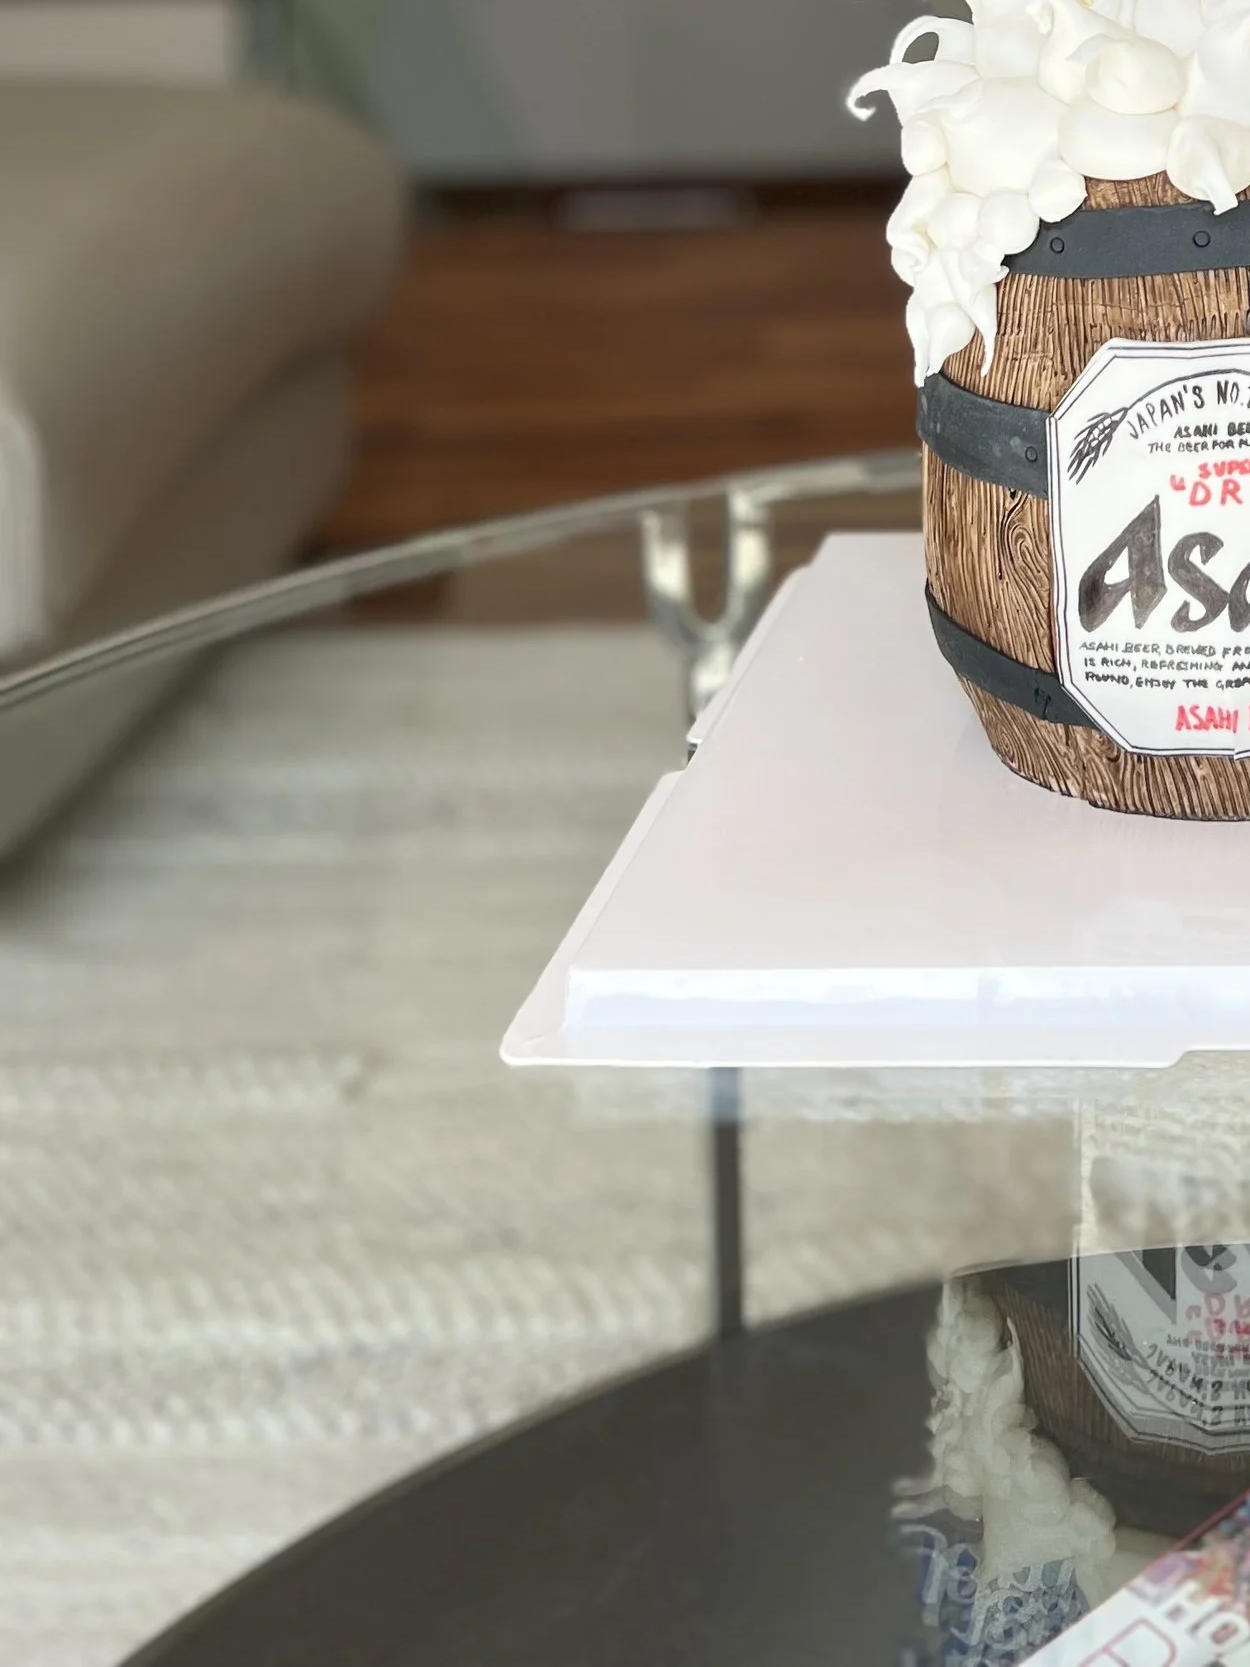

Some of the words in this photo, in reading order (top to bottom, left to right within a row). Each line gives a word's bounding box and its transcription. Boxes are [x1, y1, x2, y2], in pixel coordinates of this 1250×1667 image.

[1127, 384, 1205, 440] JAPAN'S
[1174, 422, 1218, 438] ASAHI
[1148, 442, 1171, 454] THE
[1178, 441, 1209, 452] BEER
[1212, 440, 1234, 450] FOR
[1079, 642, 1118, 652] ASAHI
[1084, 658, 1096, 666] IS
[1182, 679, 1208, 689] THE
[1176, 704, 1239, 734] ASAHI
